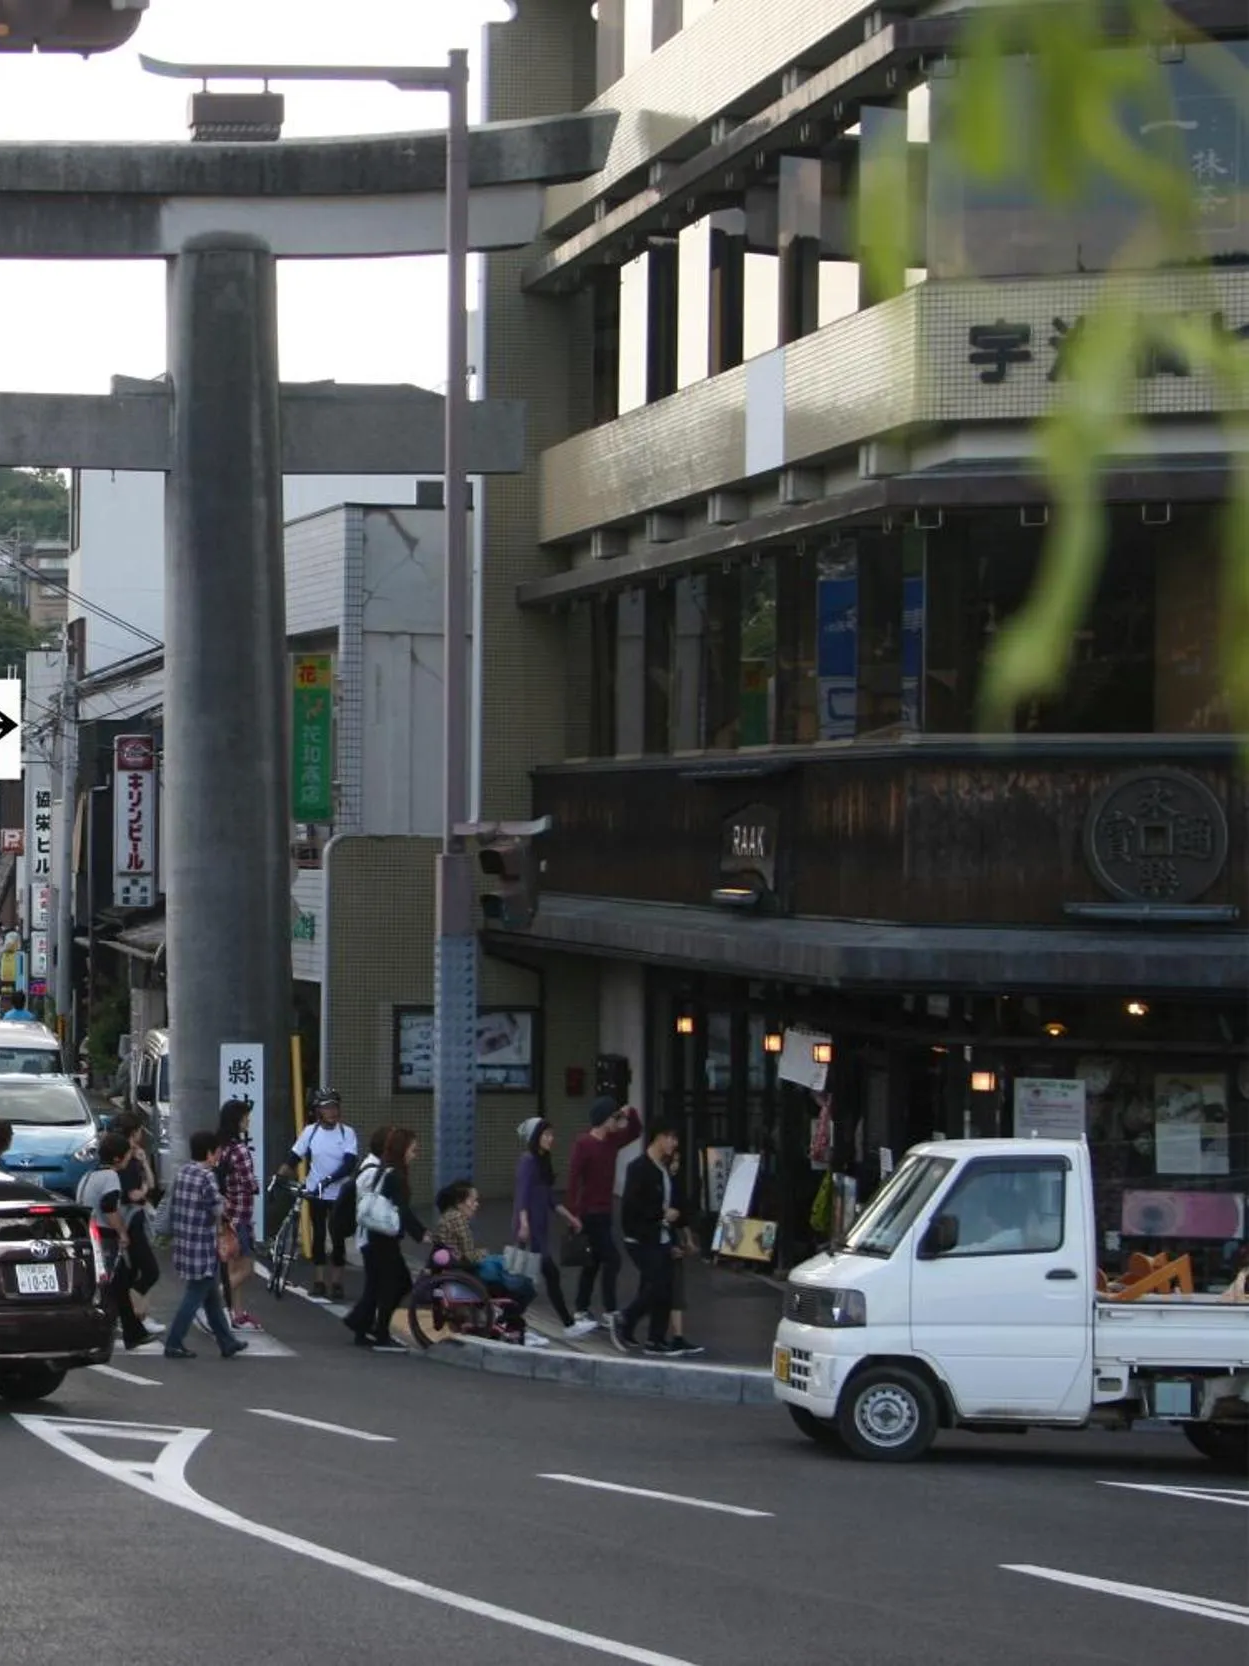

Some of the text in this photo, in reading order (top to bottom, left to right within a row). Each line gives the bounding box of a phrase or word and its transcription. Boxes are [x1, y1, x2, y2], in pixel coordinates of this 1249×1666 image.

[127, 773, 144, 870] キリンビール
